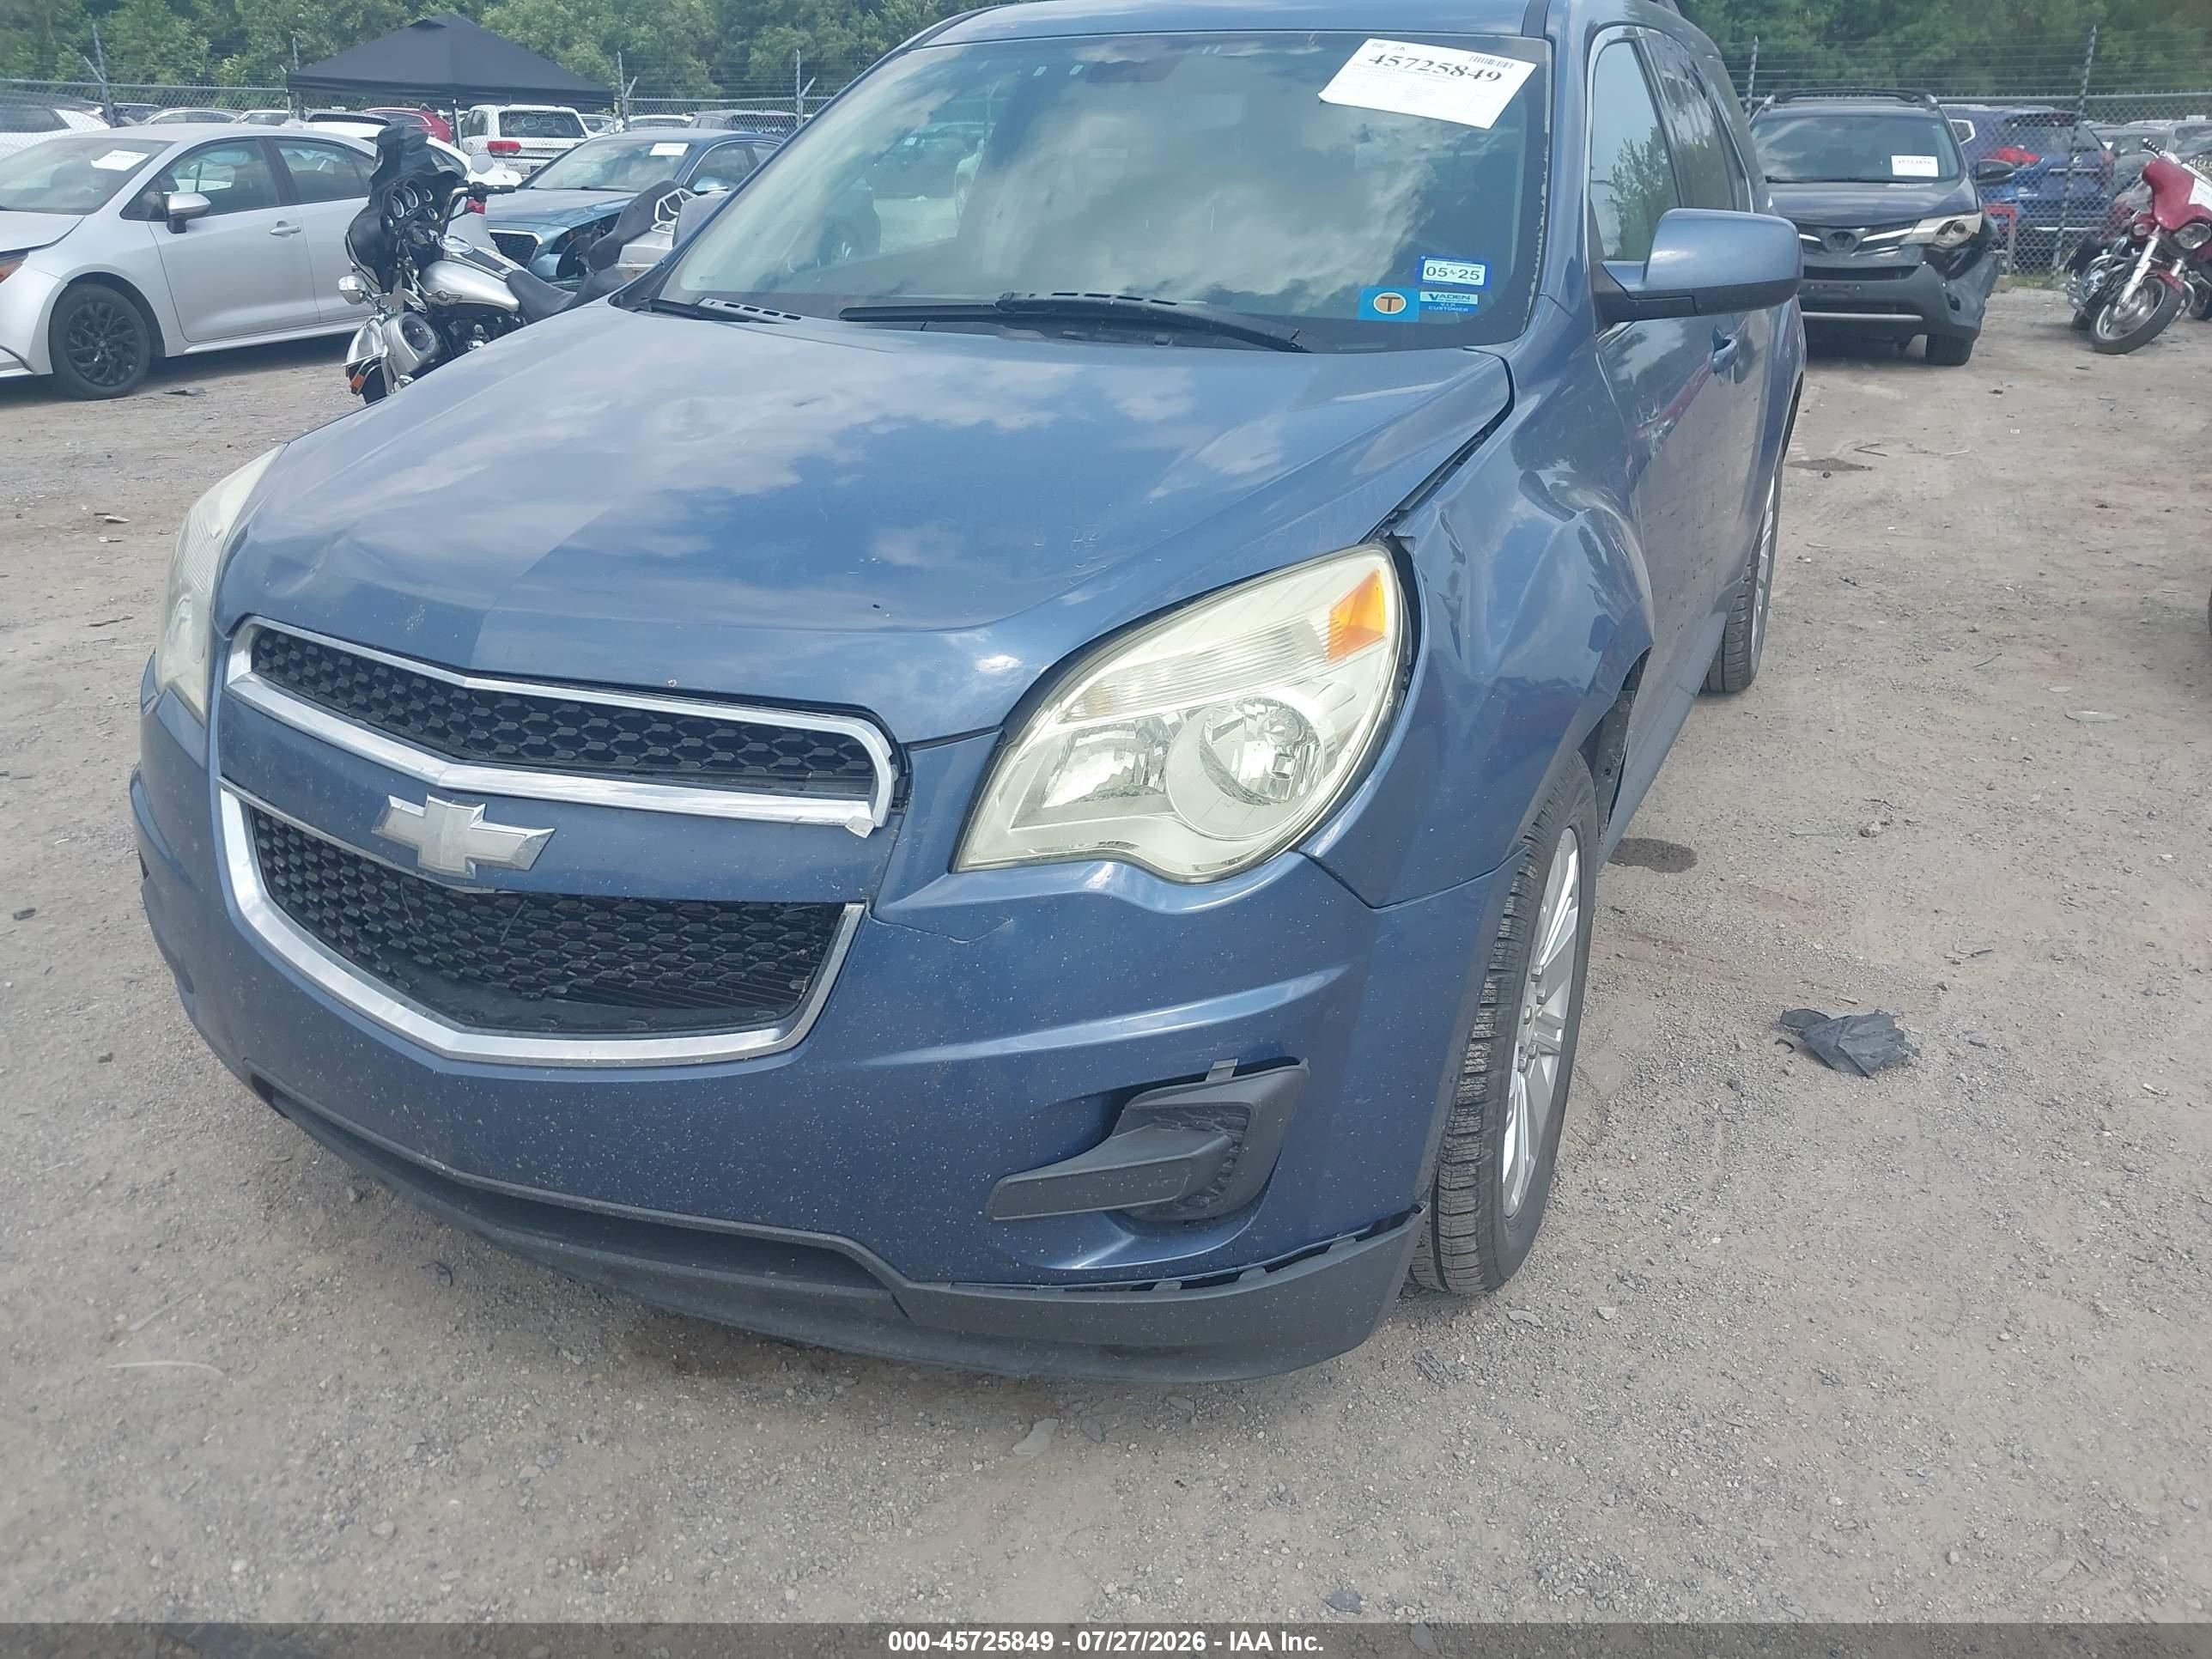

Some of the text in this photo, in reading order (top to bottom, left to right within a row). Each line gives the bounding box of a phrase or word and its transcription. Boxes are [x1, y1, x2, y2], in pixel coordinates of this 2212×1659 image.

[1368, 53, 1503, 82] 45725849
[1426, 266, 1480, 281] 05 25
[1380, 296, 1401, 313] T
